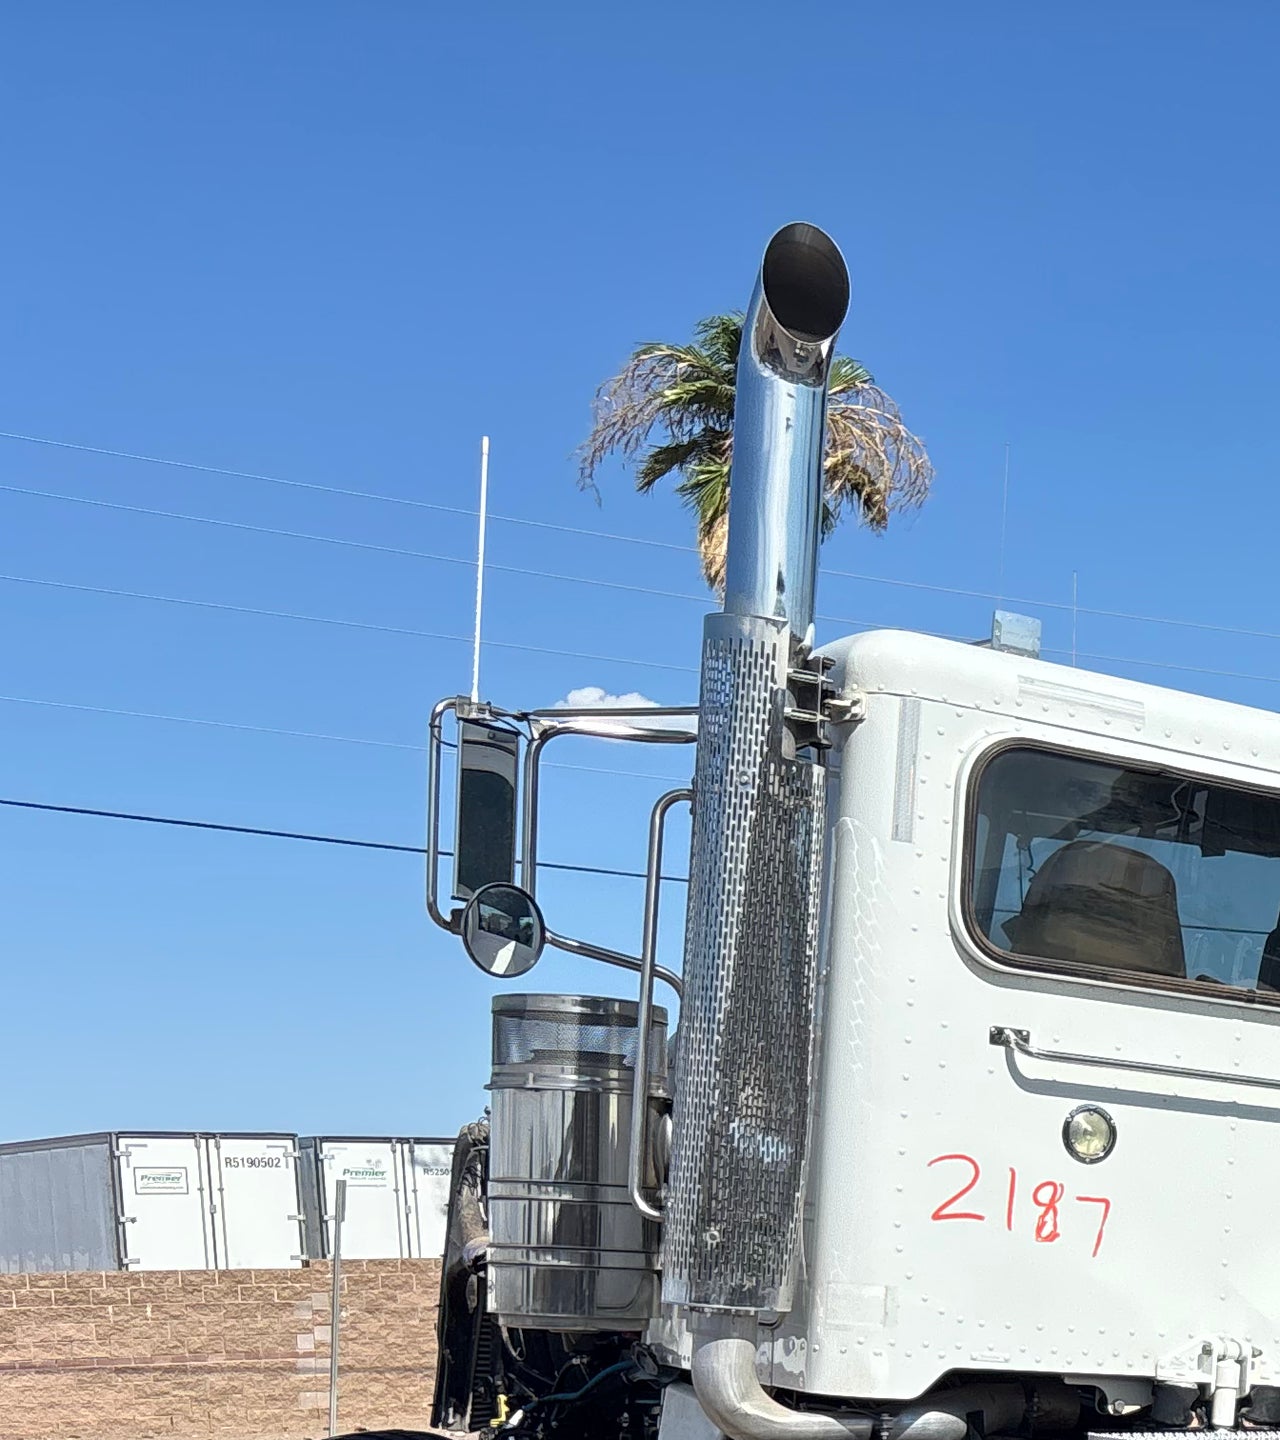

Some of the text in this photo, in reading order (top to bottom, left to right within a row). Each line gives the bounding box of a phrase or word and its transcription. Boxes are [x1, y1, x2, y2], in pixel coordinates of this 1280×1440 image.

[224, 1156, 281, 1168] R5190502
[342, 1168, 387, 1177] Premier
[423, 1167, 452, 1176] R5250
[926, 1153, 1112, 1258] 2187
